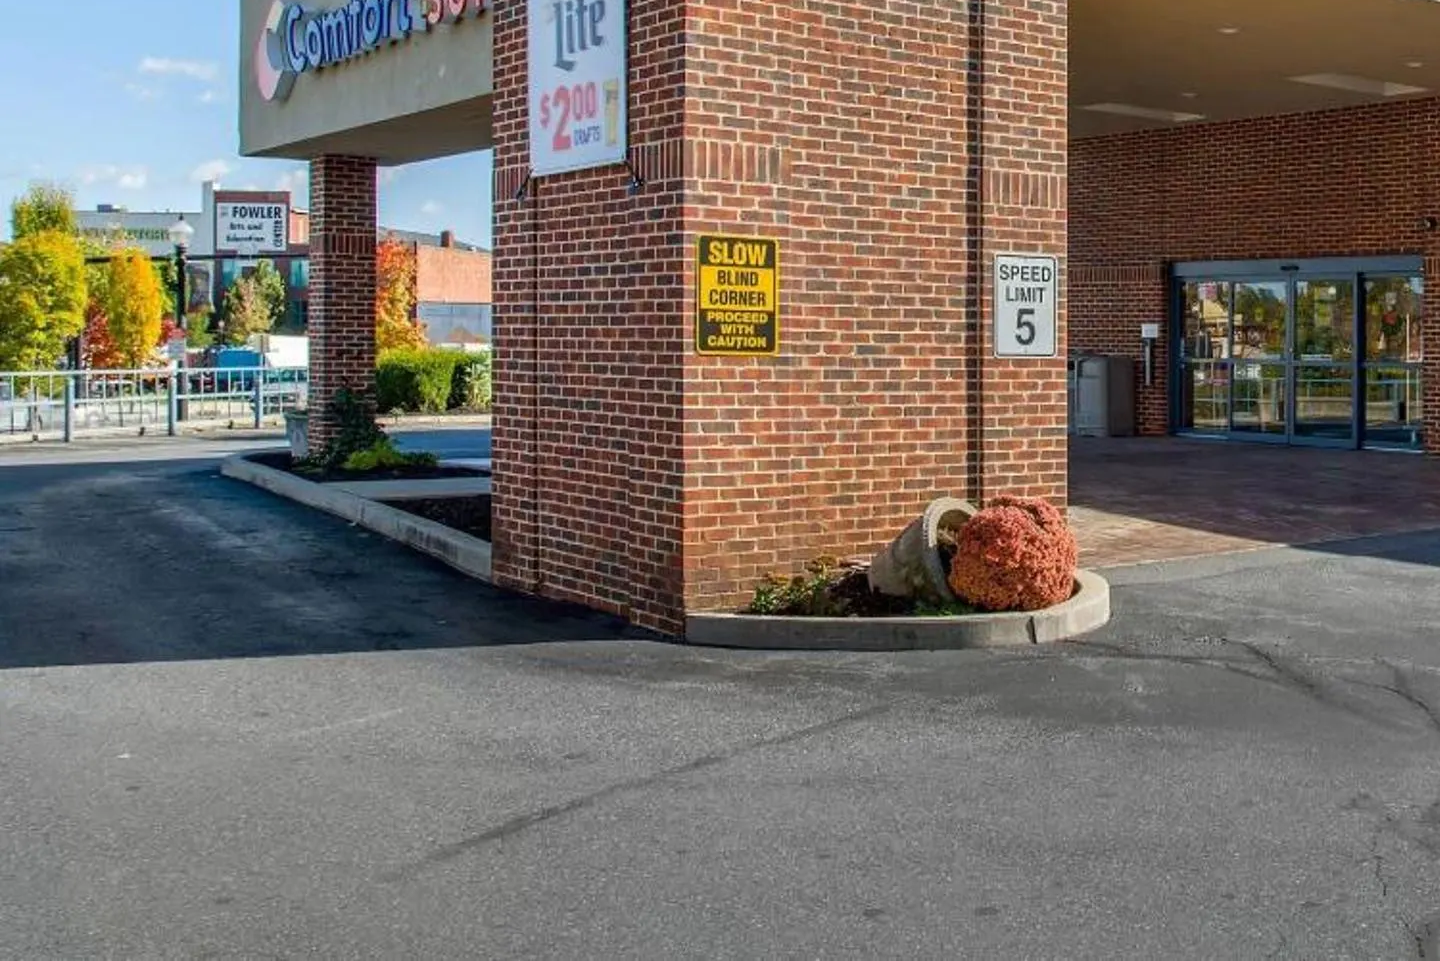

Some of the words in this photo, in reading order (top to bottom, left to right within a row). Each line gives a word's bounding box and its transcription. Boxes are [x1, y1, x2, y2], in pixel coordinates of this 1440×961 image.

[232, 205, 282, 219] FOWLER
[273, 219, 283, 248] CENTER
[708, 240, 767, 267] SLOW
[717, 269, 759, 287] BLIND
[999, 264, 1052, 283] SPEED
[709, 289, 767, 307] CORNER
[1005, 286, 1047, 304] LIMIT
[707, 311, 768, 323] PROCEED
[720, 323, 755, 335] WITH
[1014, 307, 1036, 346] 5
[707, 335, 767, 348] CAUTION
